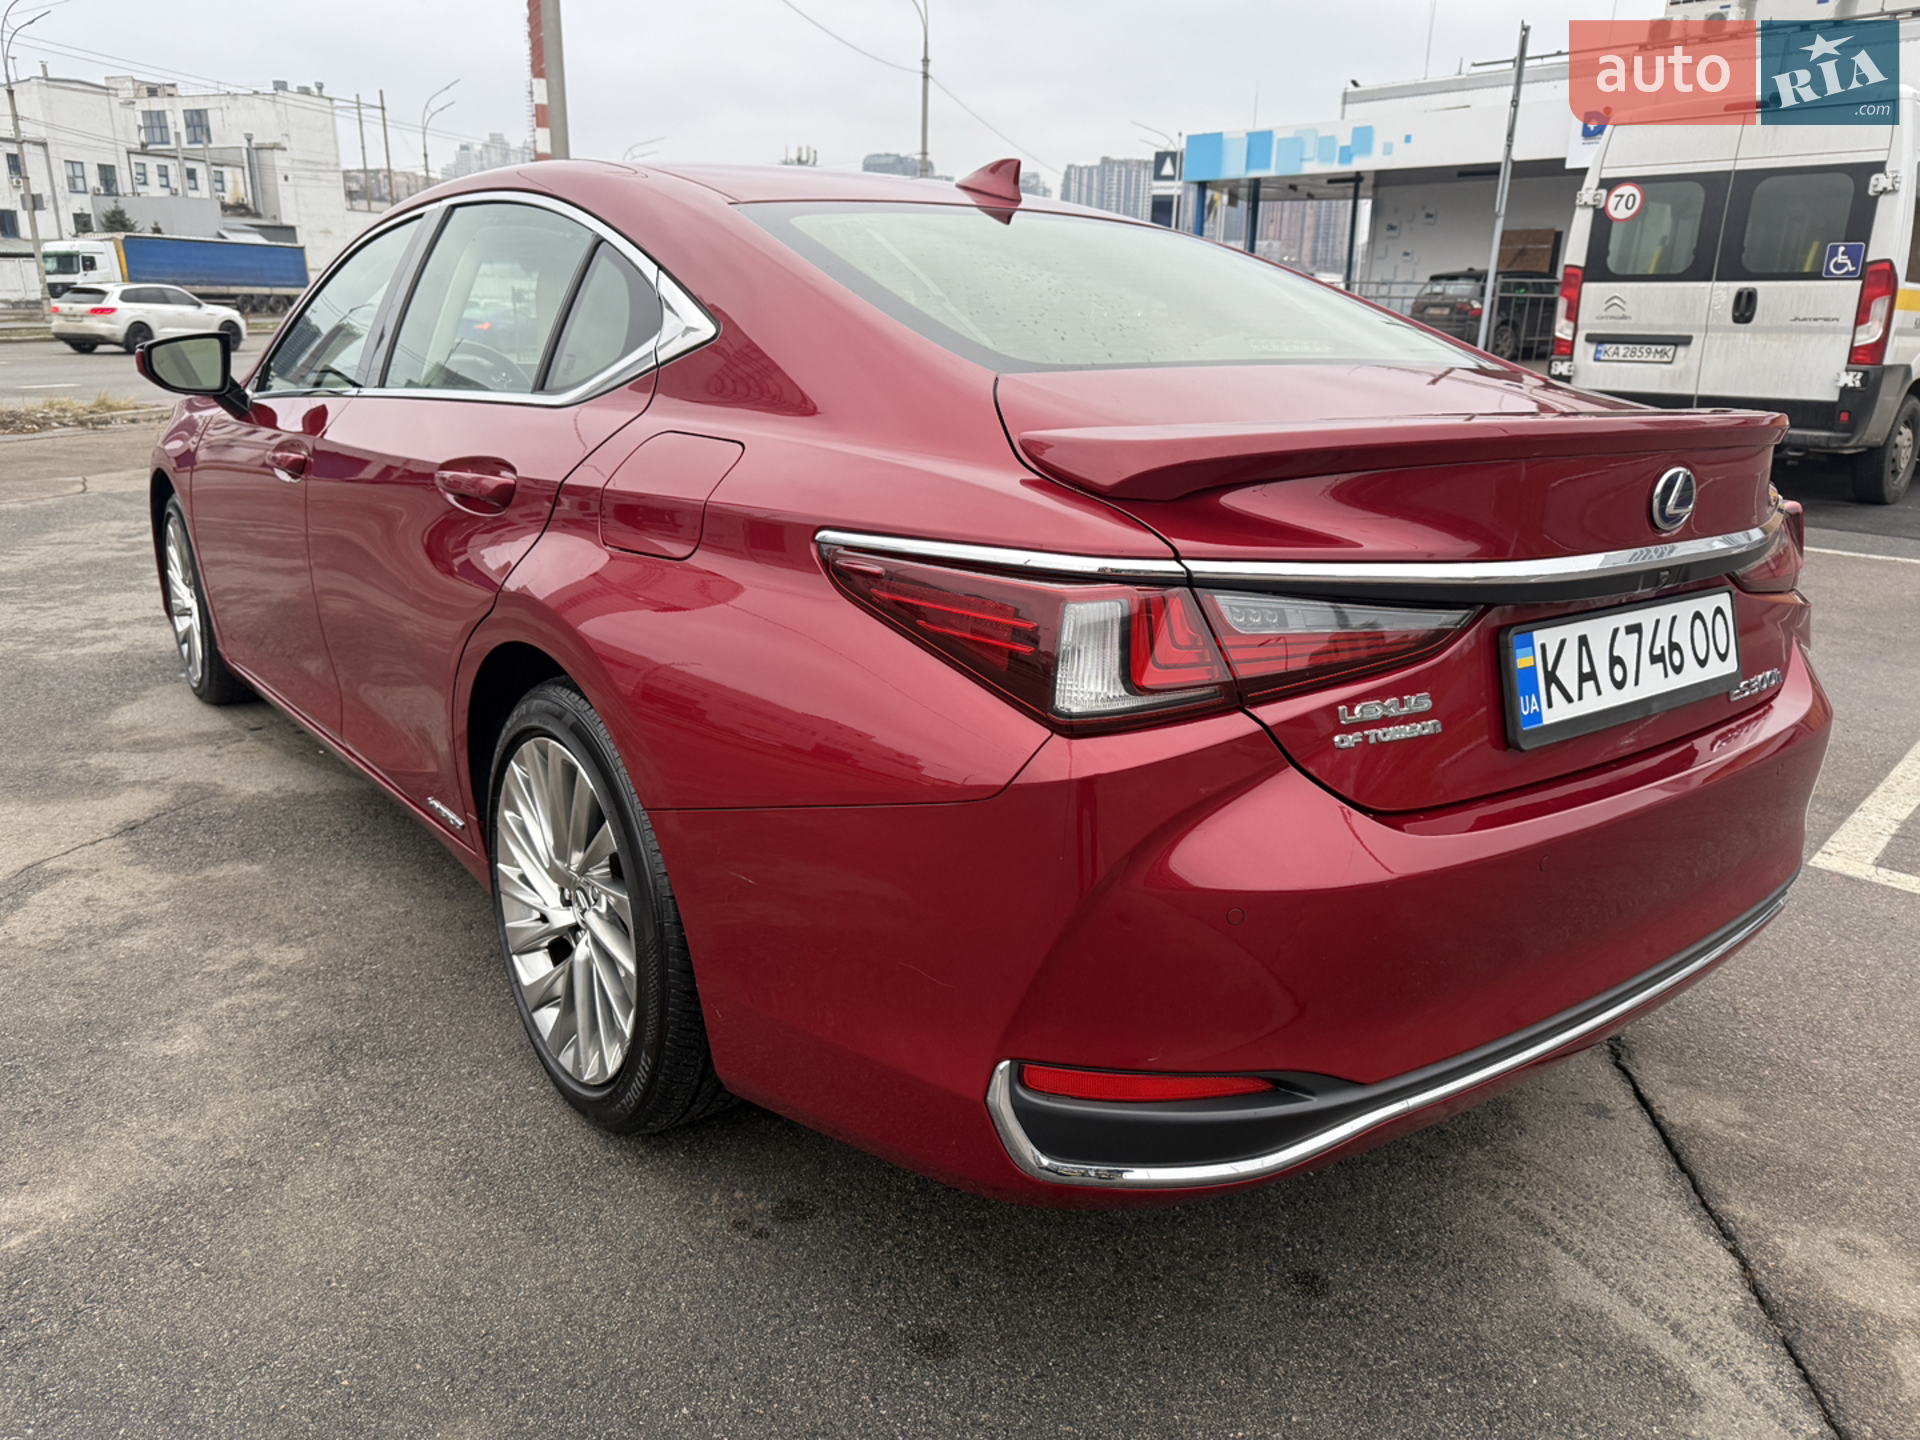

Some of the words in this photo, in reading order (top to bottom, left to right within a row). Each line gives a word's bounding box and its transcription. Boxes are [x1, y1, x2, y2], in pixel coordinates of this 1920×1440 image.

[1614, 193, 1636, 211] 70
[1338, 692, 1433, 725] LEXUS
[1520, 693, 1540, 716] UA
[1333, 731, 1363, 749] OF
